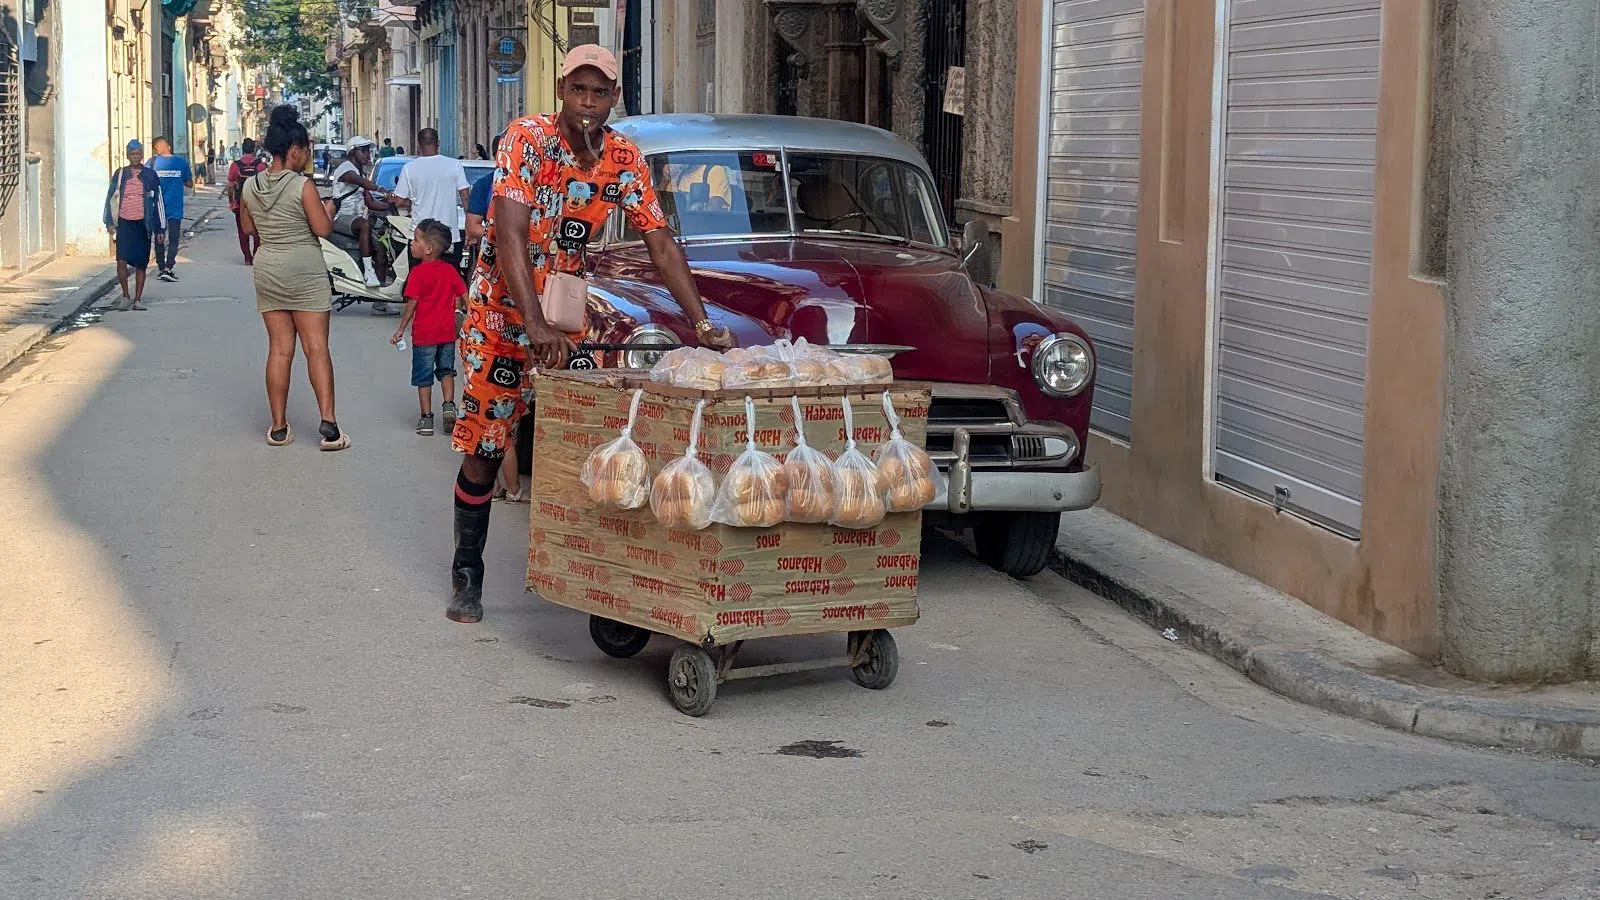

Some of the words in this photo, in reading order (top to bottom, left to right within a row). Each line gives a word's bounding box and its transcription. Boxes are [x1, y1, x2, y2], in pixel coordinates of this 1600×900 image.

[637, 403, 665, 420] abanos
[805, 406, 844, 421] Habano
[735, 429, 781, 446] Habaos
[832, 530, 876, 547] Habanos
[777, 556, 823, 574] Habanos
[785, 579, 830, 596] Habanos
[885, 575, 917, 590] abanos
[716, 610, 765, 627] Habanos
[822, 605, 866, 621] Habanos
